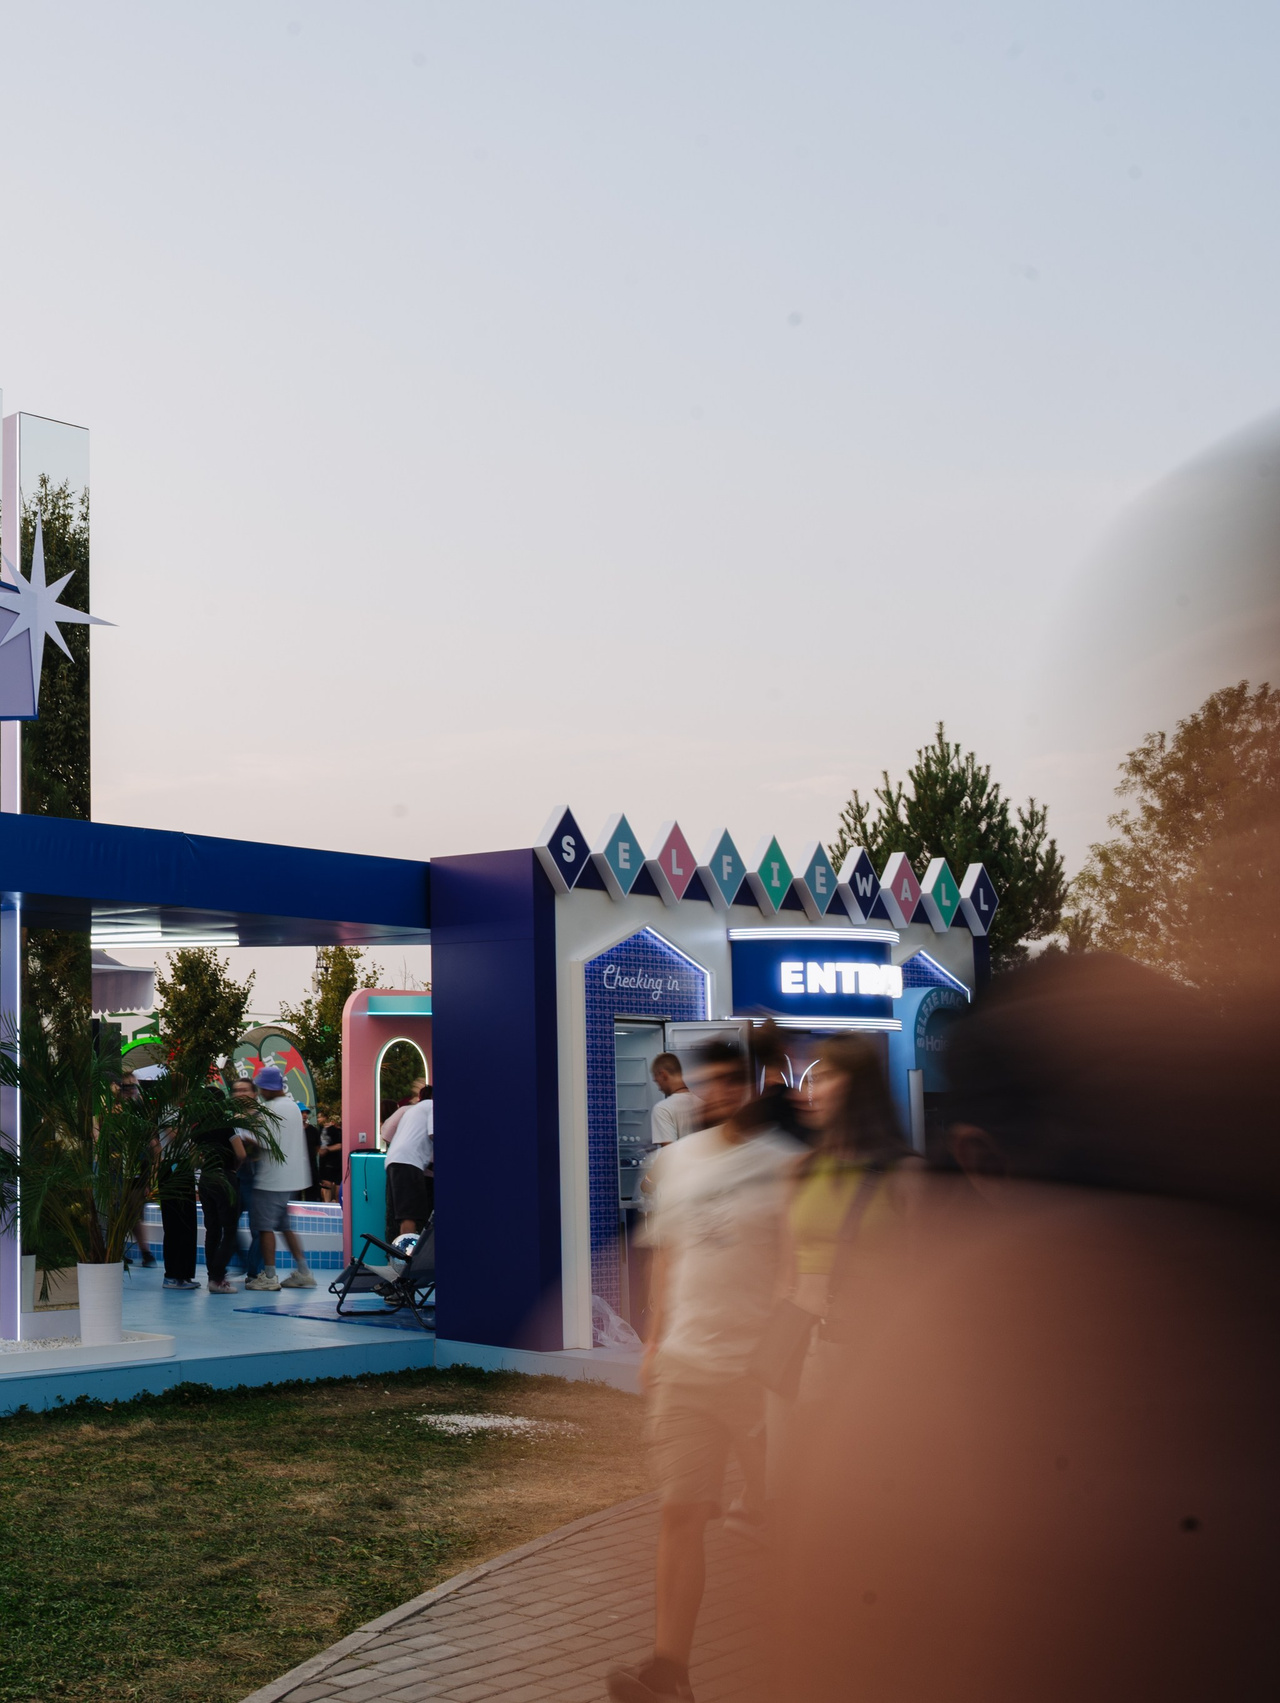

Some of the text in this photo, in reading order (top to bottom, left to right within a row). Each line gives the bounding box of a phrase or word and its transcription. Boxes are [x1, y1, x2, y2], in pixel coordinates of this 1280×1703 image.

[602, 964, 680, 1001] Checking in
[916, 991, 940, 1049] SELFIE
